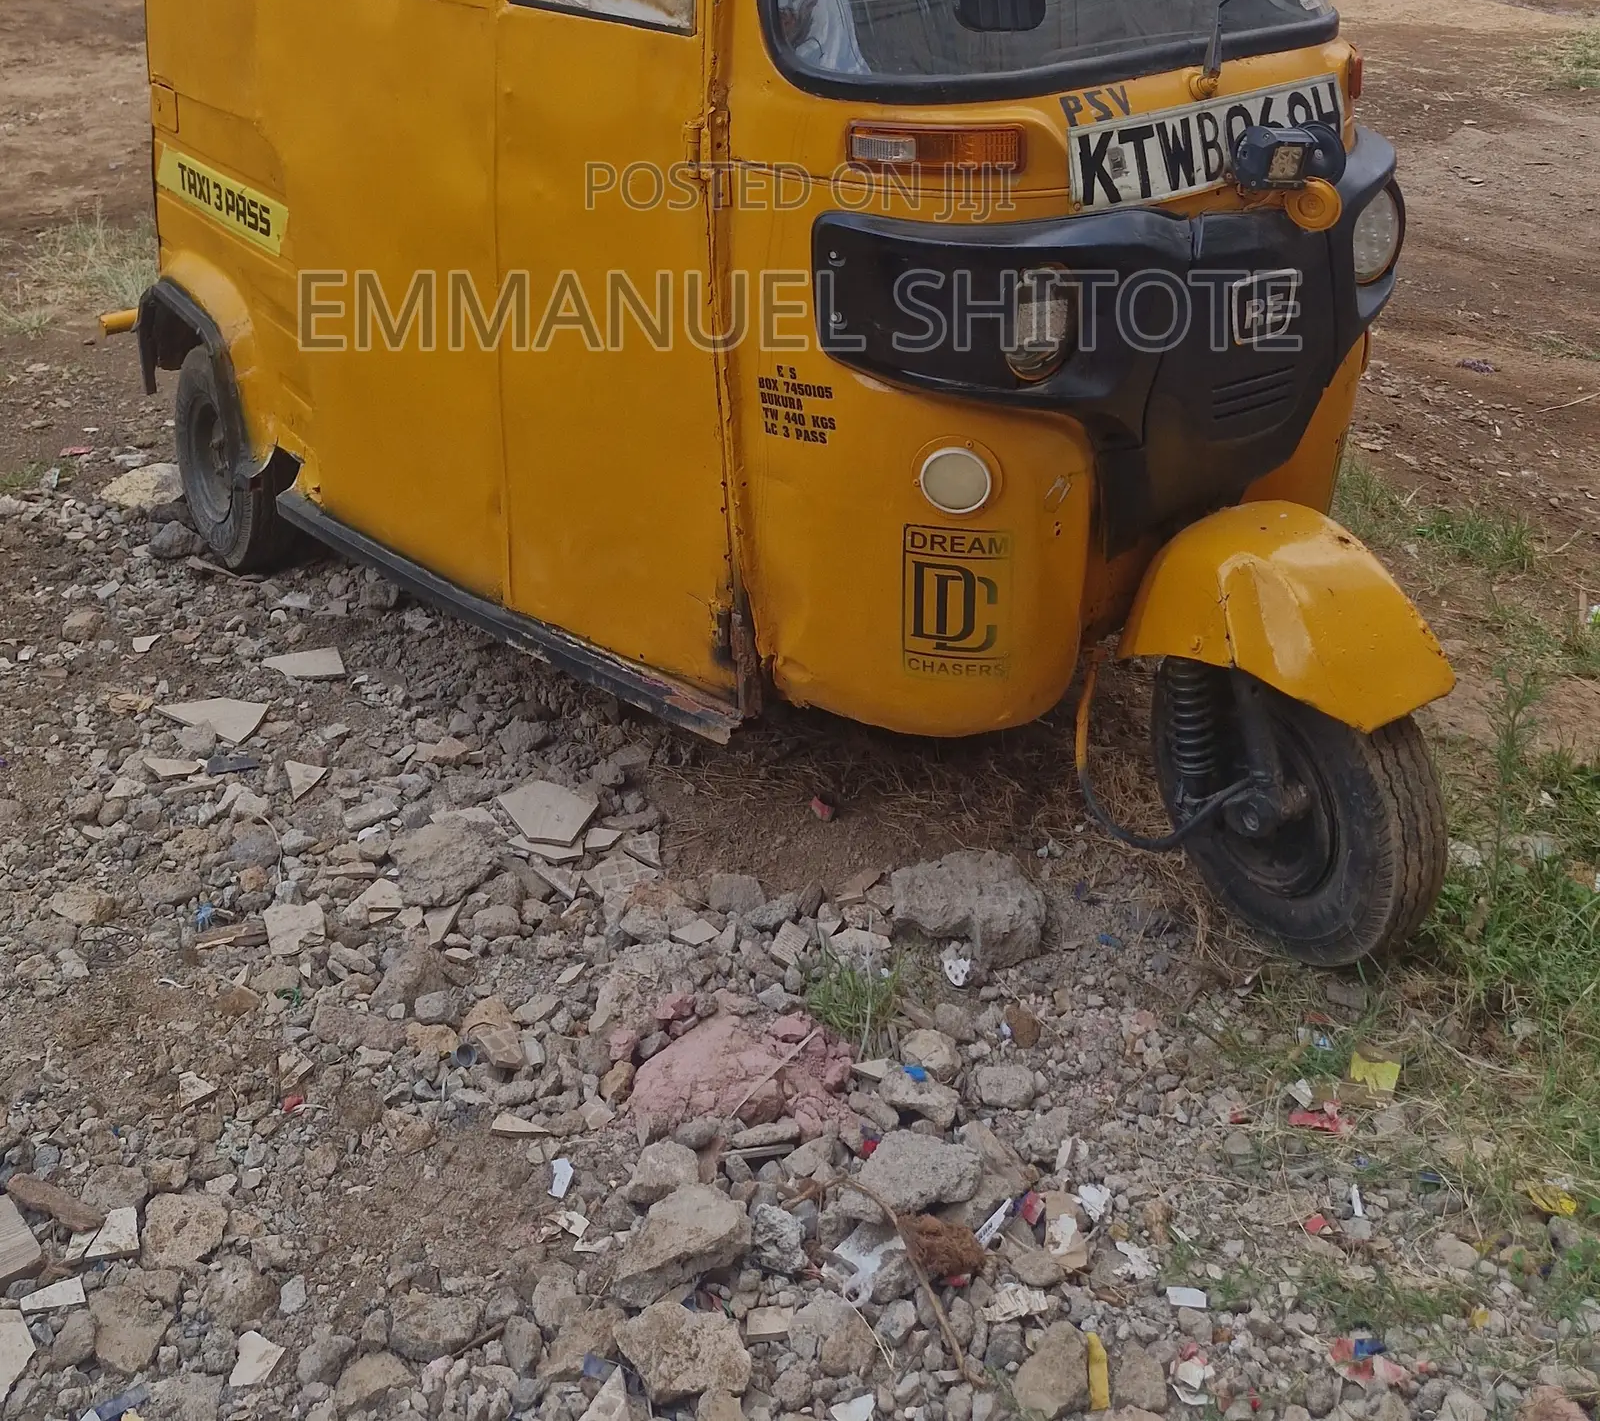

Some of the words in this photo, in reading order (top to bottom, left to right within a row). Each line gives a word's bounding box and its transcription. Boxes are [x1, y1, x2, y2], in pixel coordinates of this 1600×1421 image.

[1059, 85, 1132, 127] PSV
[178, 162, 211, 206] TAXI
[213, 181, 223, 211] 3
[225, 188, 271, 237] PASS
[1244, 293, 1284, 329] RE
[776, 364, 785, 378] E
[789, 367, 797, 379] S
[758, 377, 779, 392] BOX
[783, 381, 833, 399] 7450105
[760, 392, 803, 411] BUKURA
[762, 407, 779, 421] TW
[784, 411, 806, 427] 440
[811, 414, 836, 430] KGS
[782, 425, 790, 438] 3
[795, 428, 827, 445] PASS
[910, 531, 1009, 555] DREAM
